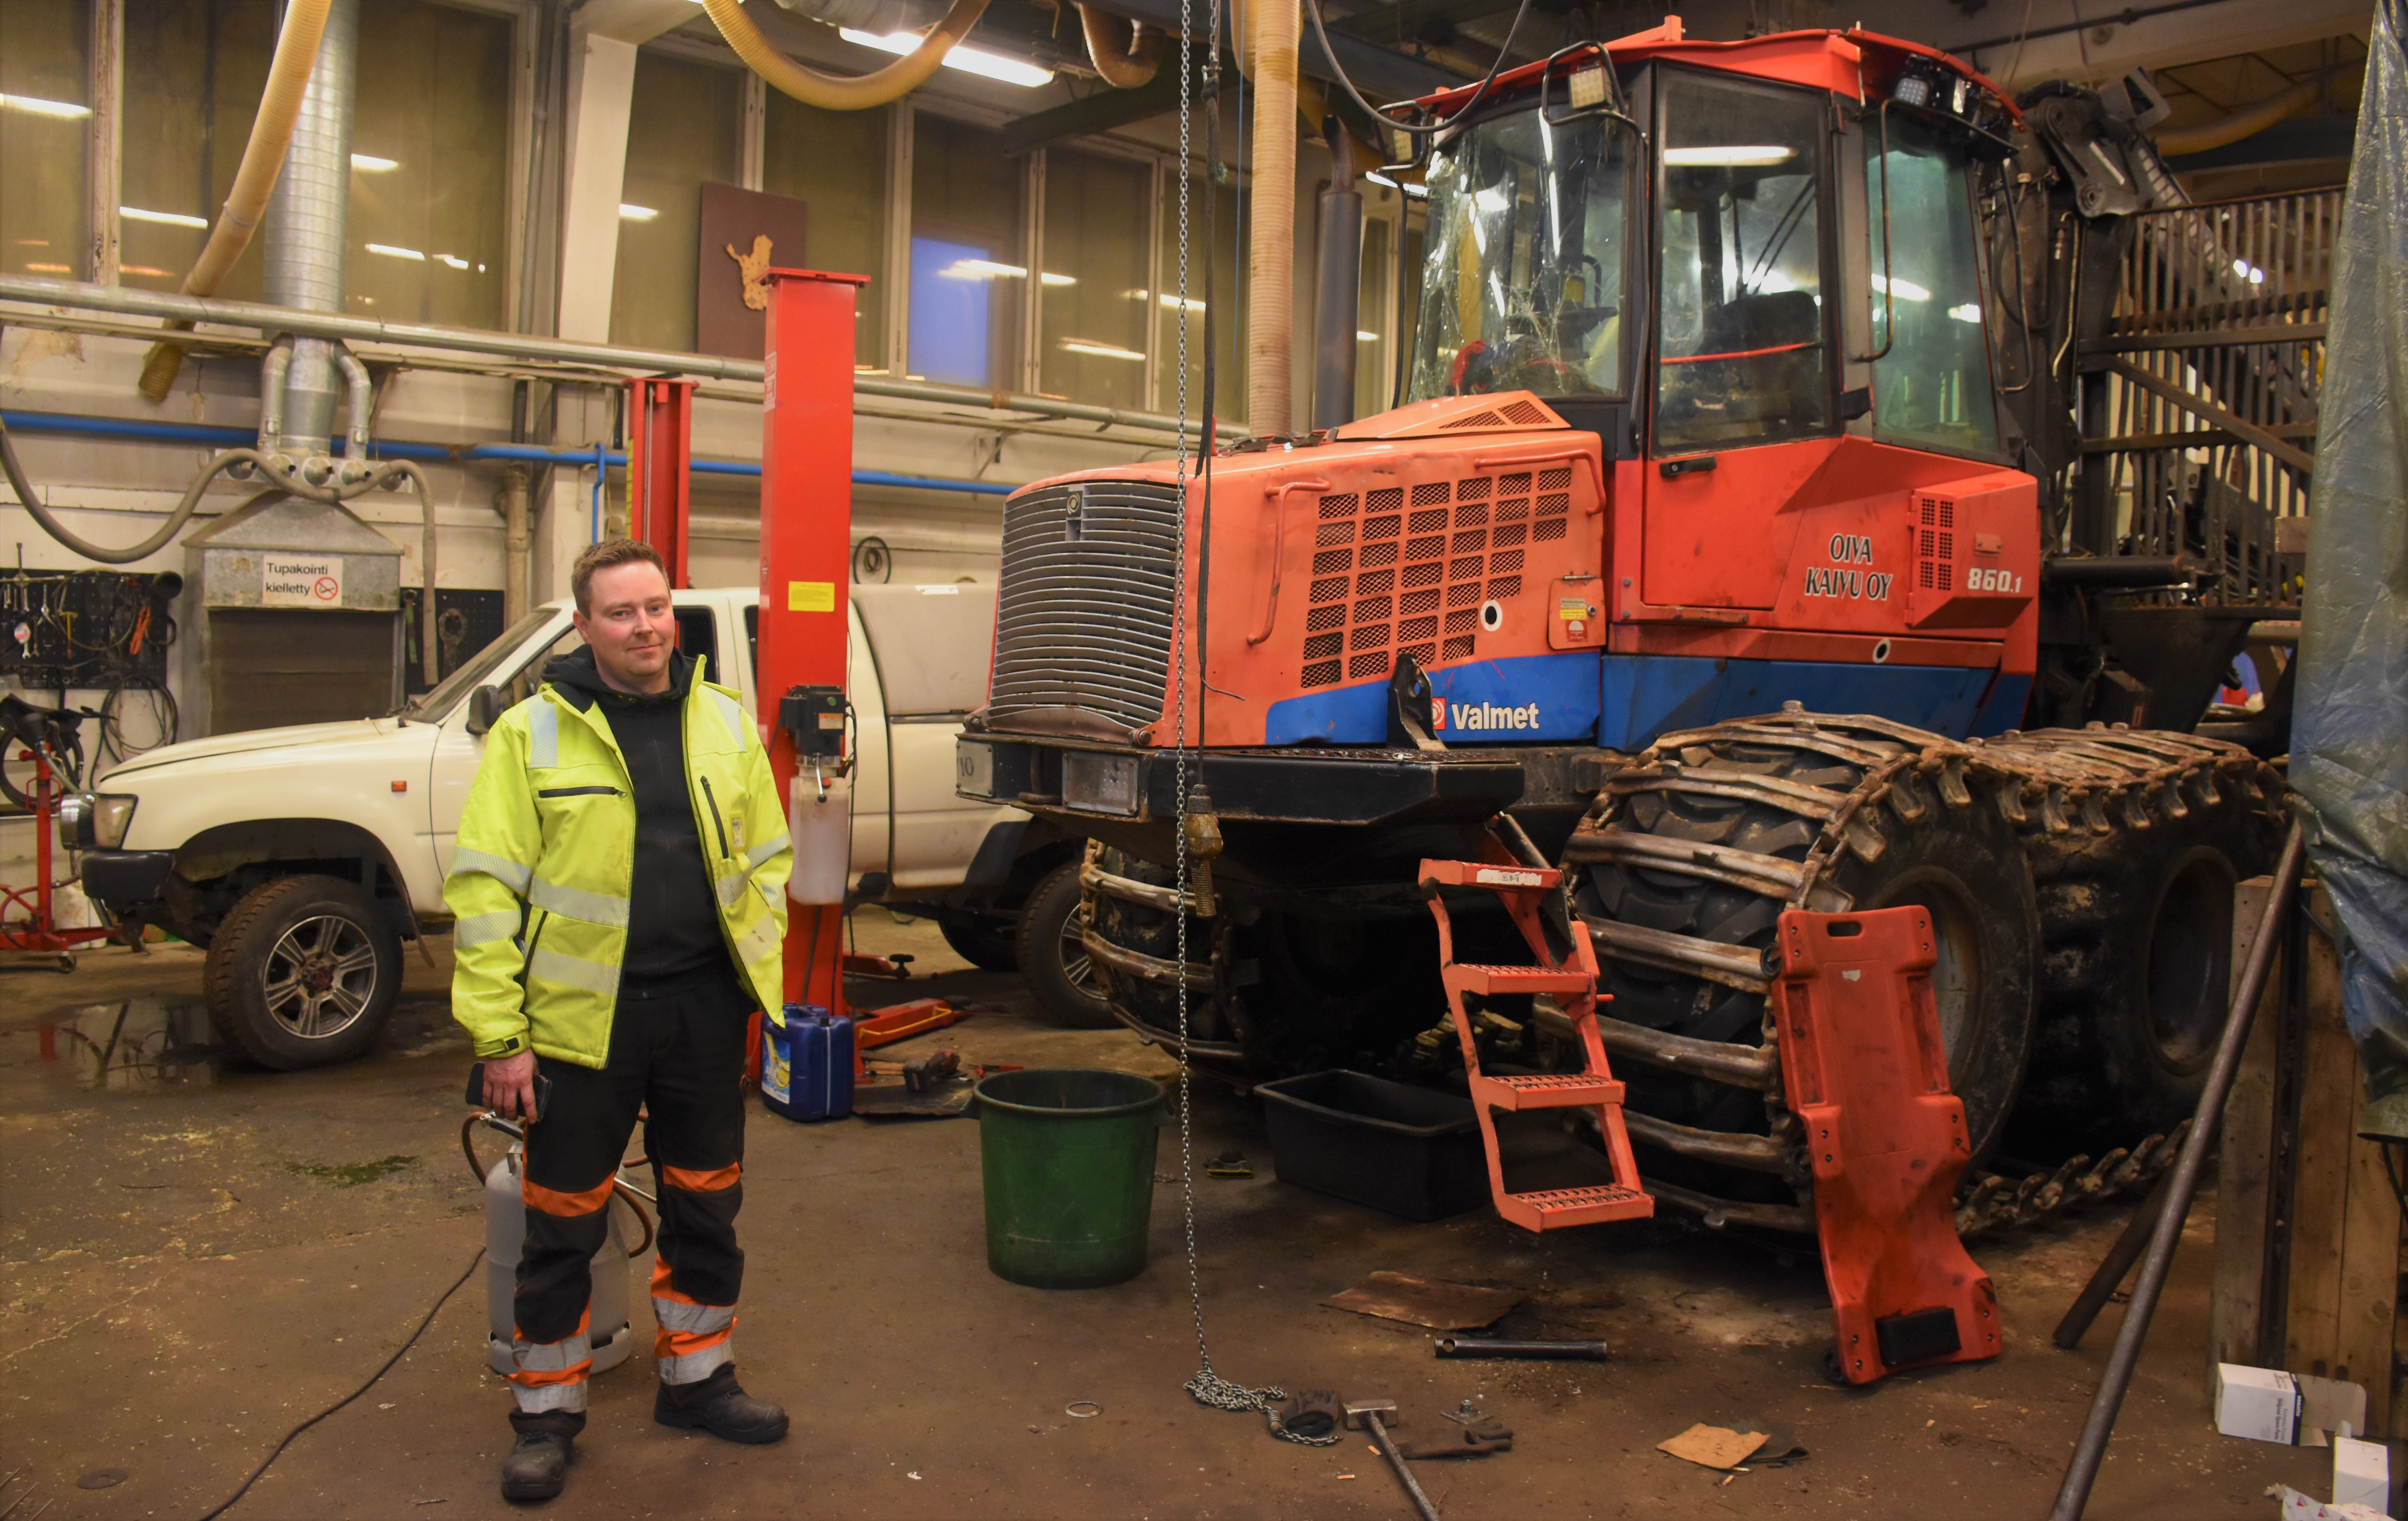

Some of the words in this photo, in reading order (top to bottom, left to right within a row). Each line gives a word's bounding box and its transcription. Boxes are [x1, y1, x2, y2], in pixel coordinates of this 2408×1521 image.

[1829, 533, 1873, 565] OIVA
[267, 563, 328, 576] Tupakointi
[1967, 567, 2022, 594] 860.1
[266, 582, 310, 596] kielletty
[1805, 567, 1863, 599] KAIVU
[1866, 571, 1894, 601] OY
[1451, 701, 1539, 730] Valmet
